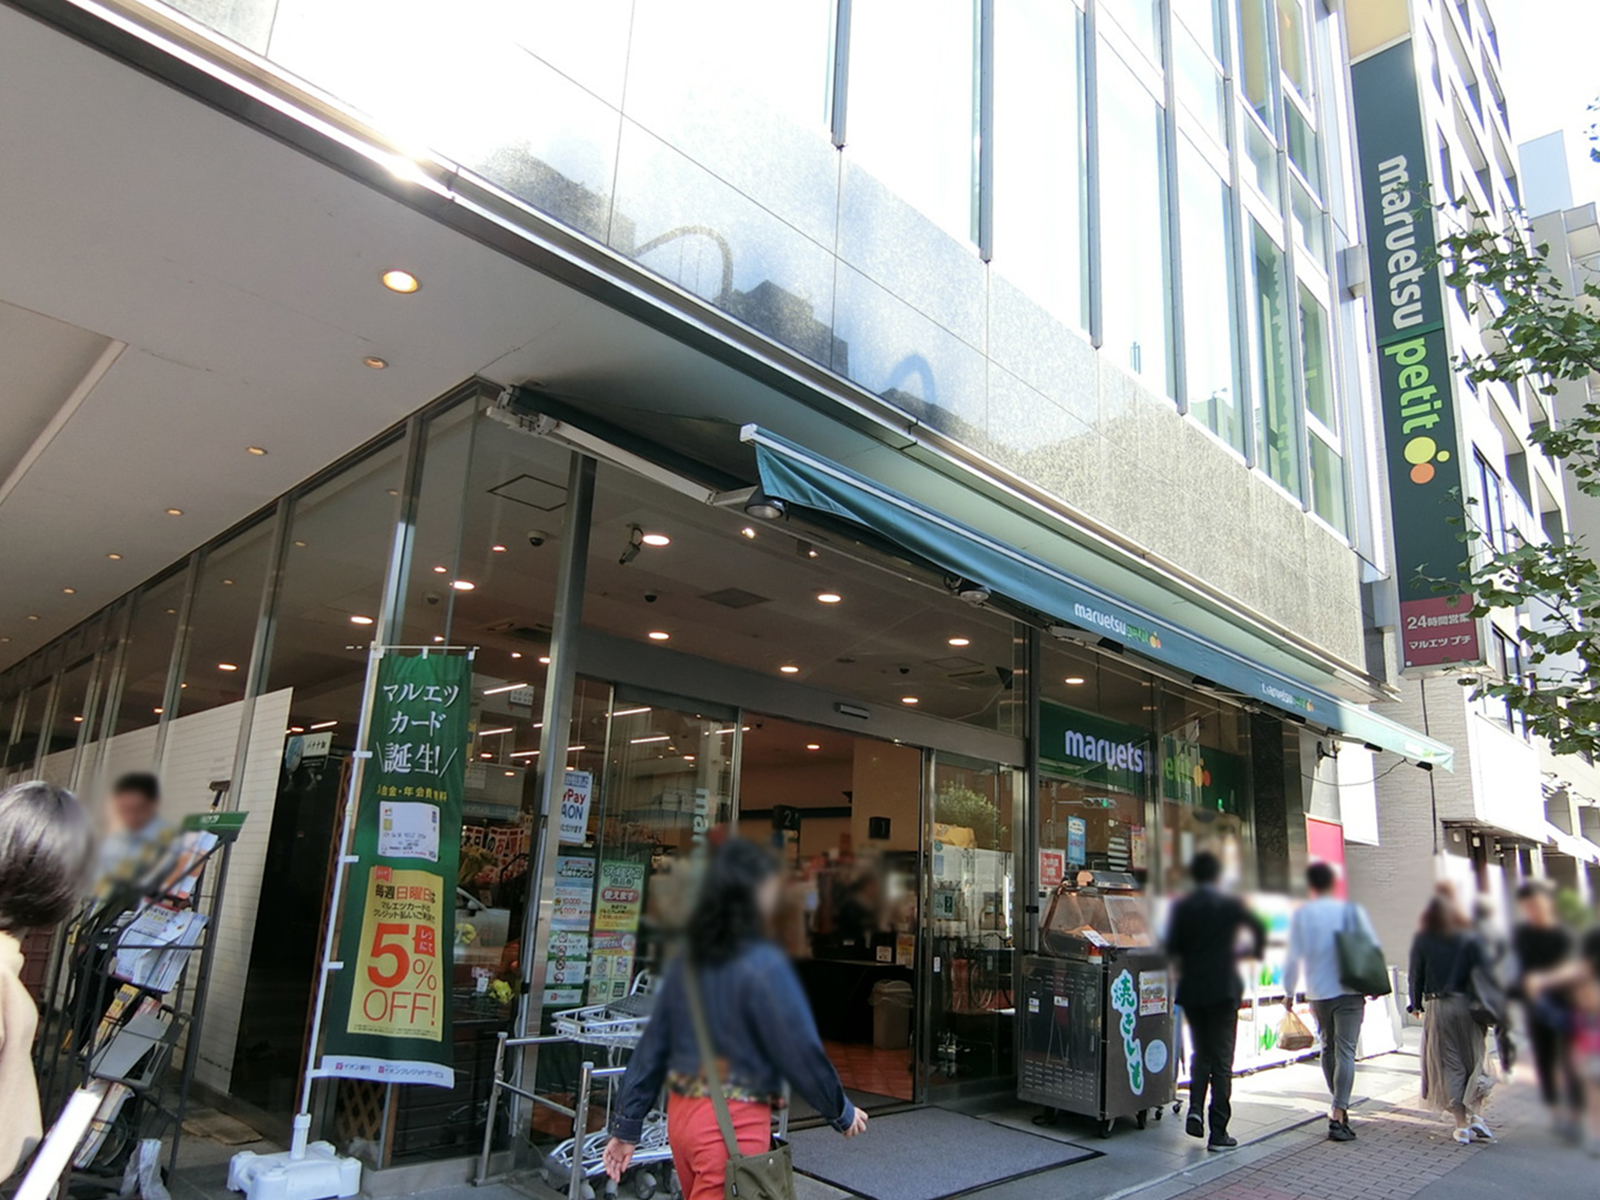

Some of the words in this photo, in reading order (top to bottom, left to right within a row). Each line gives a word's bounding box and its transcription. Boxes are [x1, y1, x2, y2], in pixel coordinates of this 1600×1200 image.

[1378, 154, 1426, 330] maruetsu
[1384, 336, 1444, 435] petit
[1074, 603, 1127, 636] maruetsu
[1409, 638, 1448, 650] マルエツ
[1450, 635, 1472, 645] プチ
[383, 683, 459, 708] マルエツ
[388, 710, 447, 737] カード
[1065, 730, 1144, 773] maruets
[363, 989, 437, 1027] OFF!
